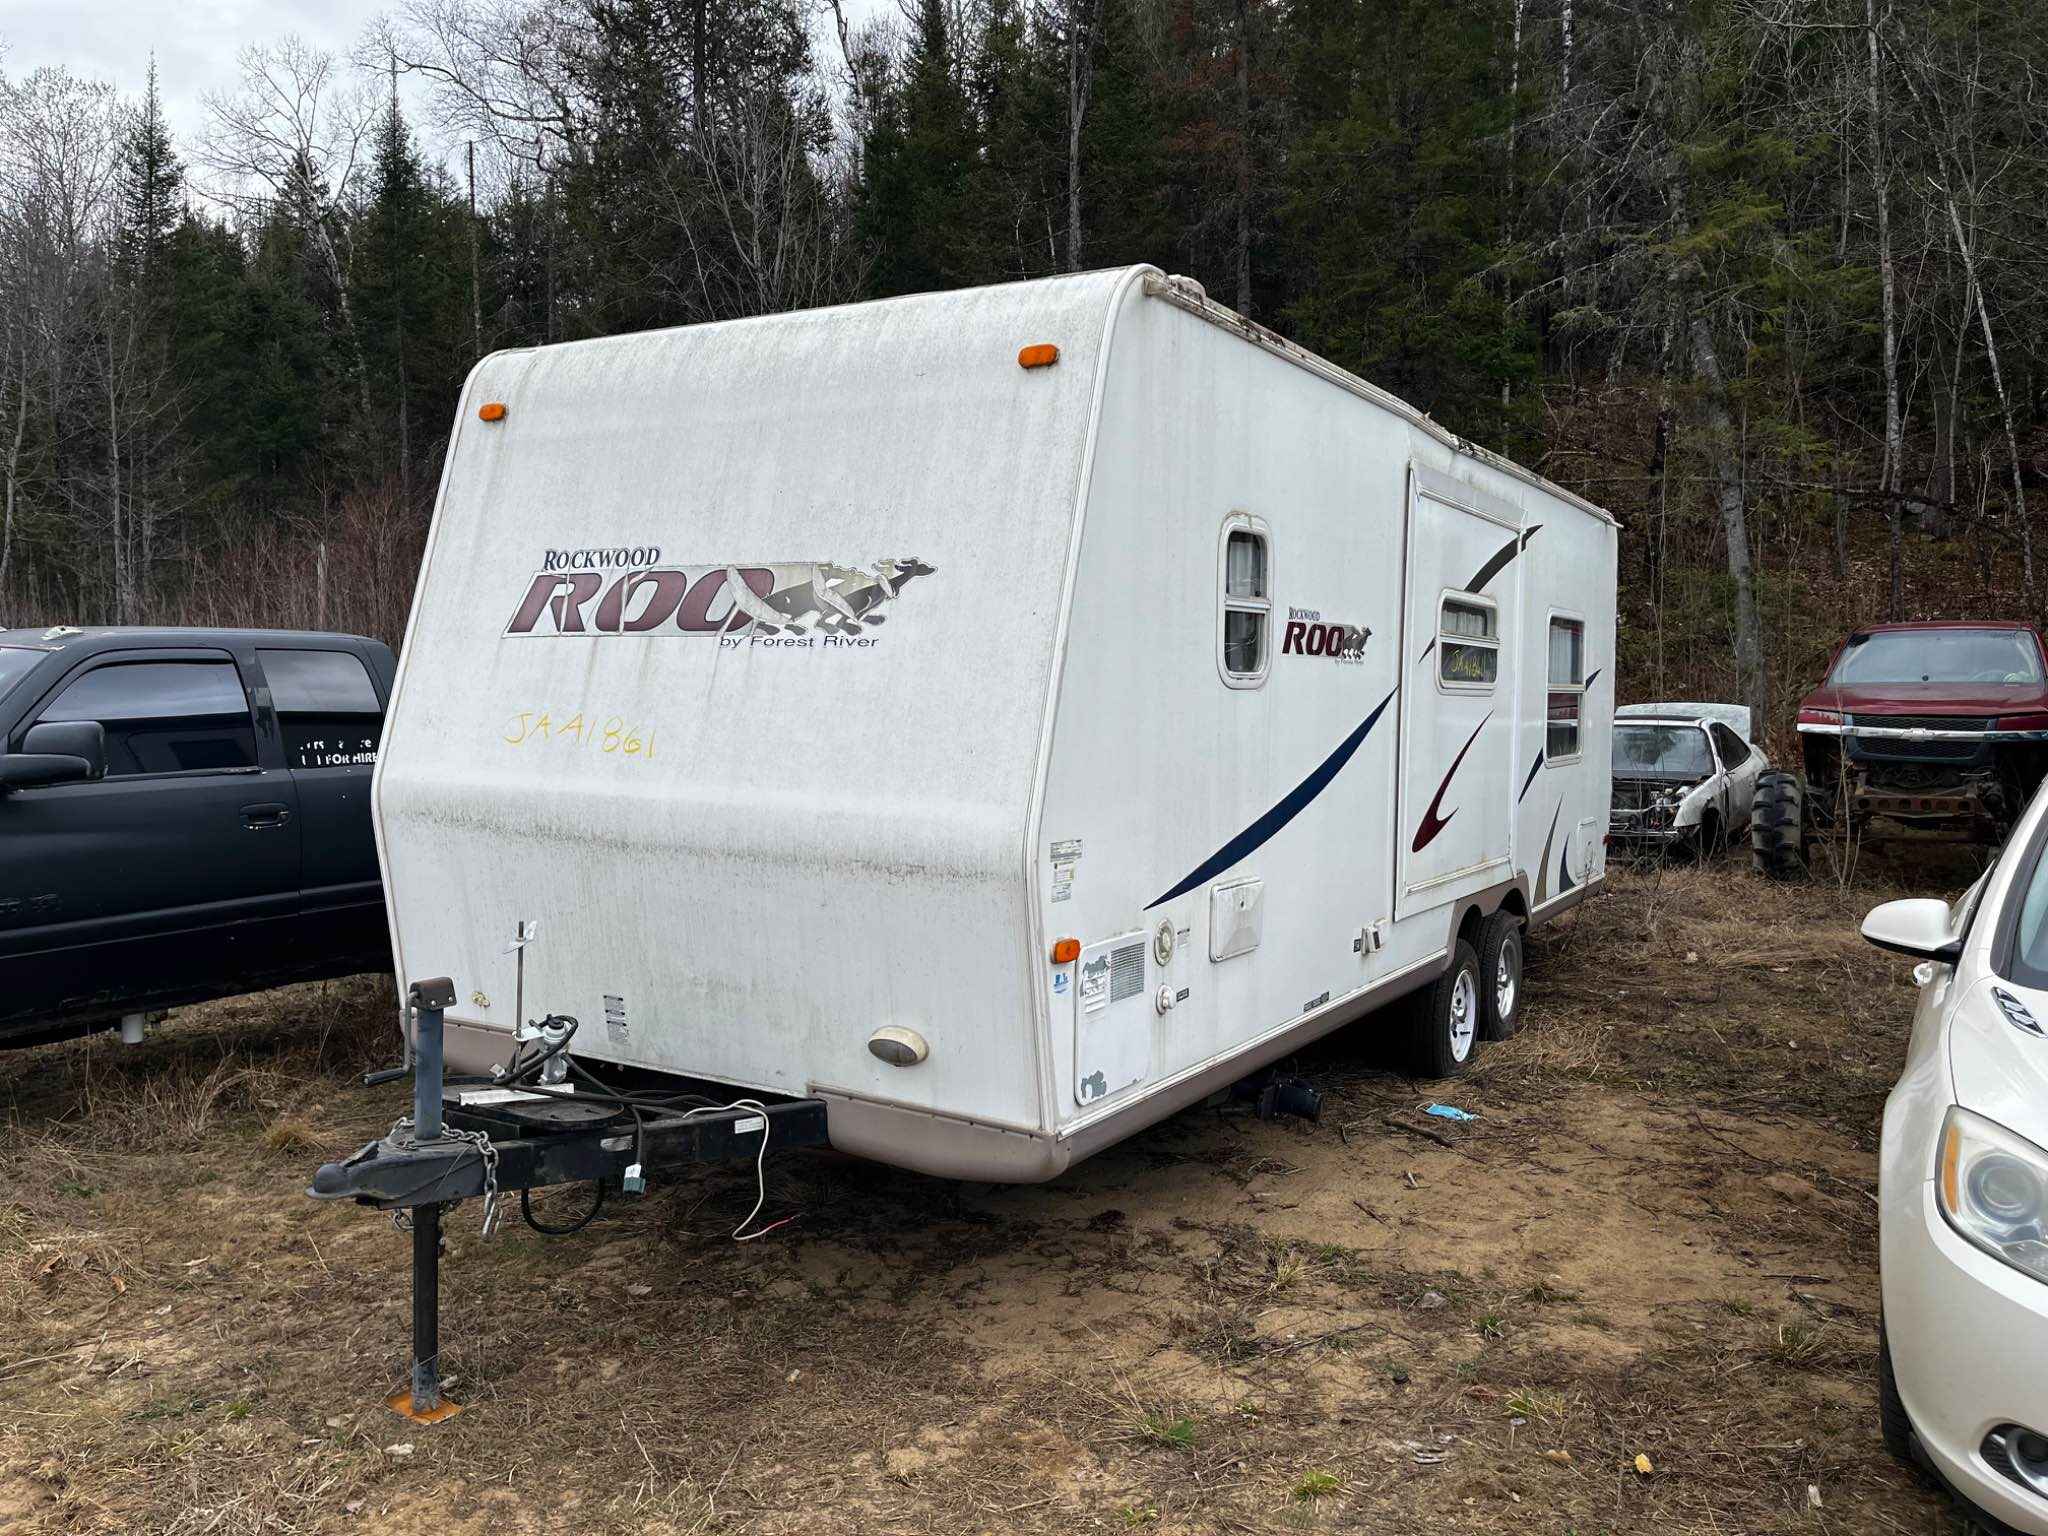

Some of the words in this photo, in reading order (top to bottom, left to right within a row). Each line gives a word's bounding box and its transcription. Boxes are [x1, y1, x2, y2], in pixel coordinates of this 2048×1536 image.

[543, 546, 662, 571] ROCKWOOD
[719, 635, 743, 649] by
[750, 635, 815, 648] Forest
[823, 635, 880, 648] River
[1282, 621, 1345, 657] ROO
[326, 753, 350, 765] FOR
